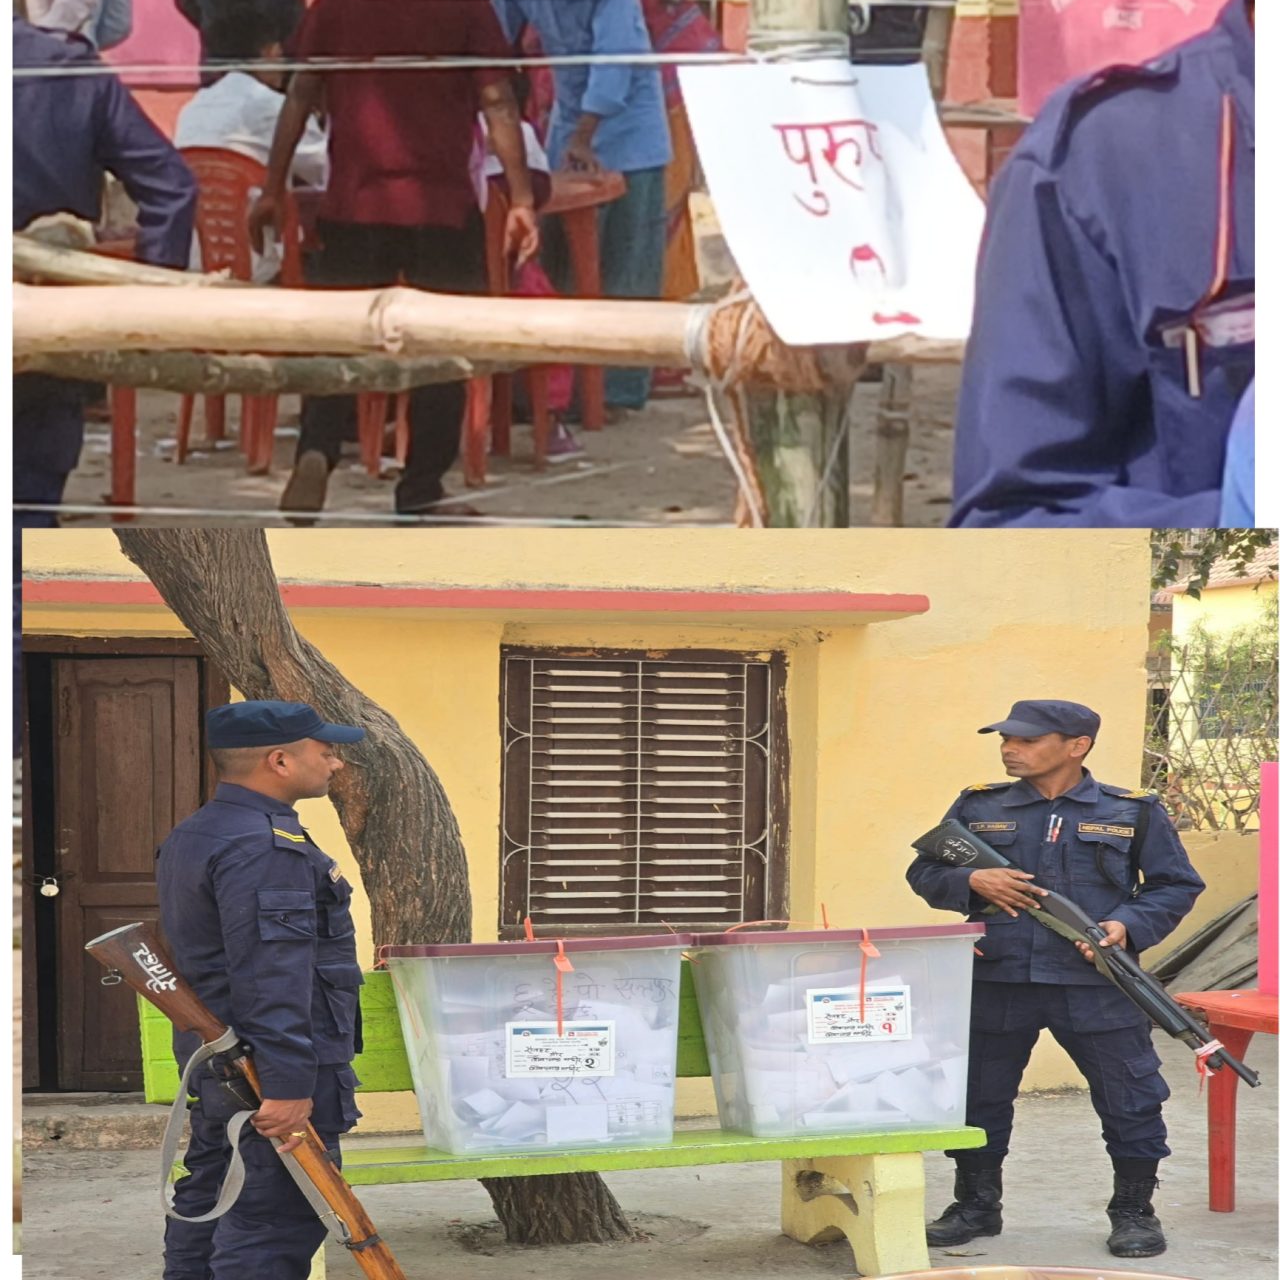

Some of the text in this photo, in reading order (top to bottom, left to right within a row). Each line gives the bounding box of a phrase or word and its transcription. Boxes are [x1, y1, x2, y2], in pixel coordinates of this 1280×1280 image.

[132, 942, 177, 994] रौतहट
[882, 1022, 892, 1033] १
[584, 1057, 595, 1069] २
